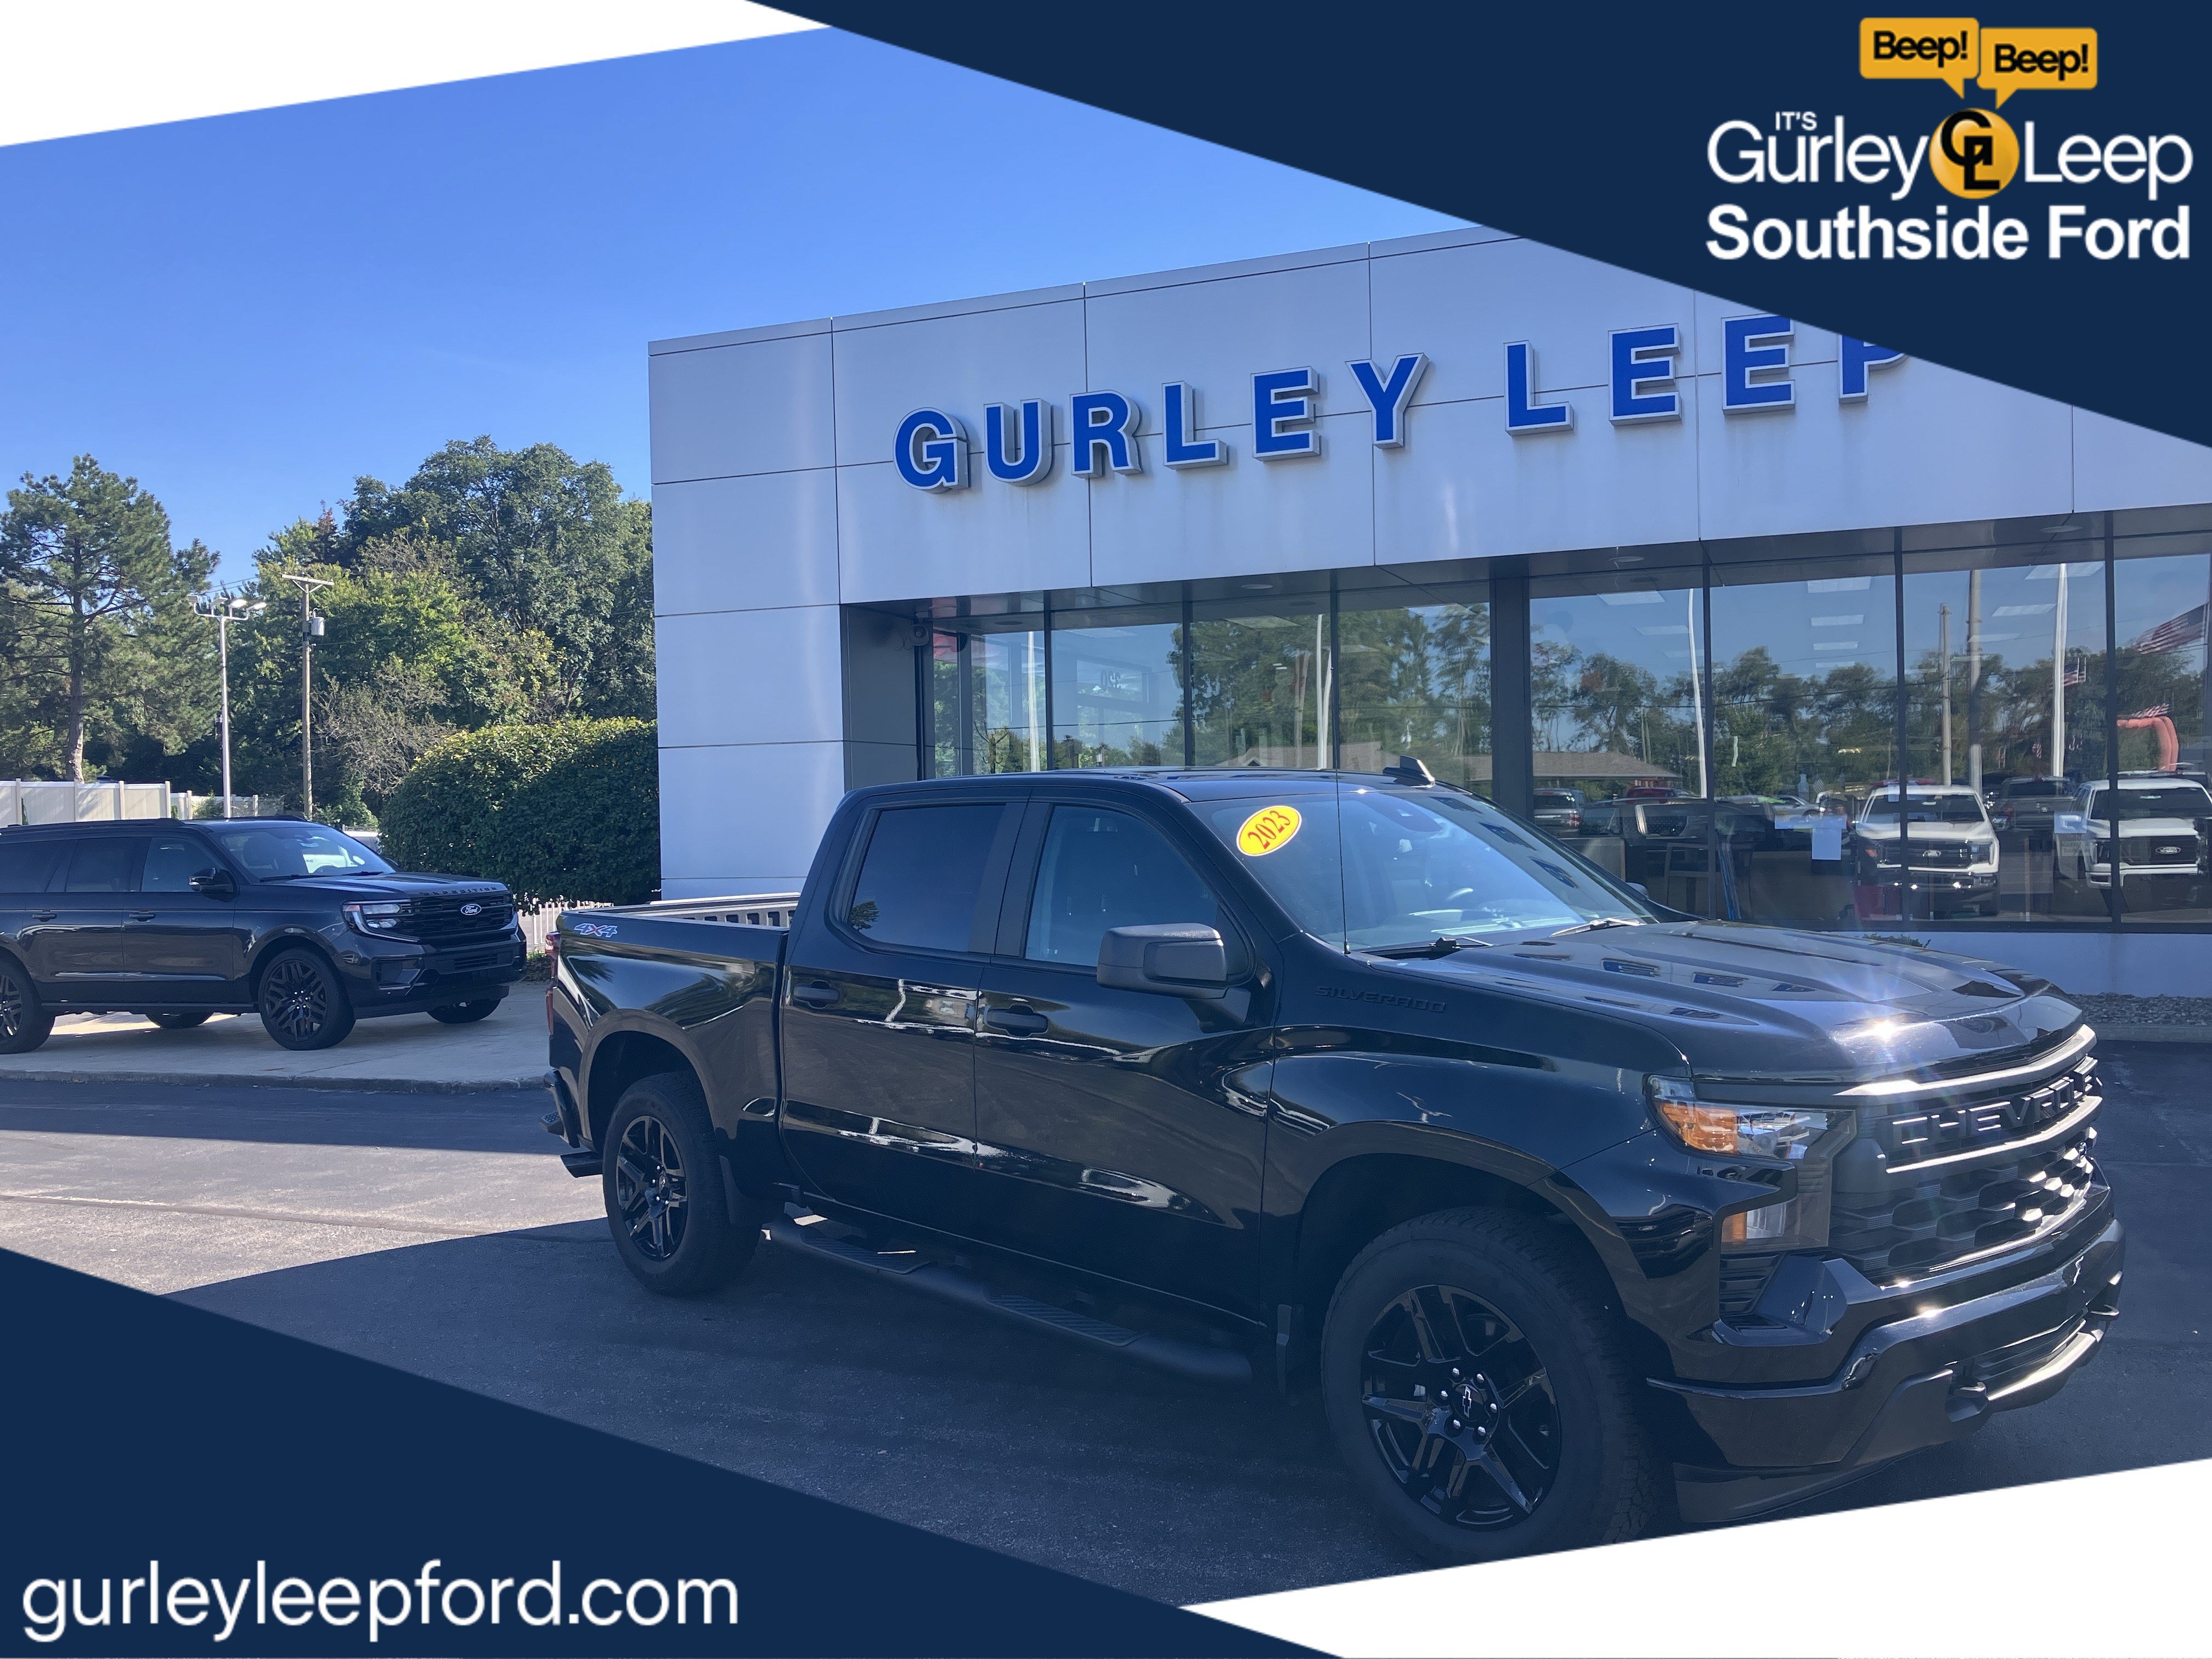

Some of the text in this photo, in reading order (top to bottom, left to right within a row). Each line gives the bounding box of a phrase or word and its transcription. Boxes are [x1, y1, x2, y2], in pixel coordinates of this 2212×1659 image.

[893, 352, 1429, 494] GURLEY
[1248, 810, 1290, 850] 2023
[1314, 985, 1447, 1013] SILVERADO
